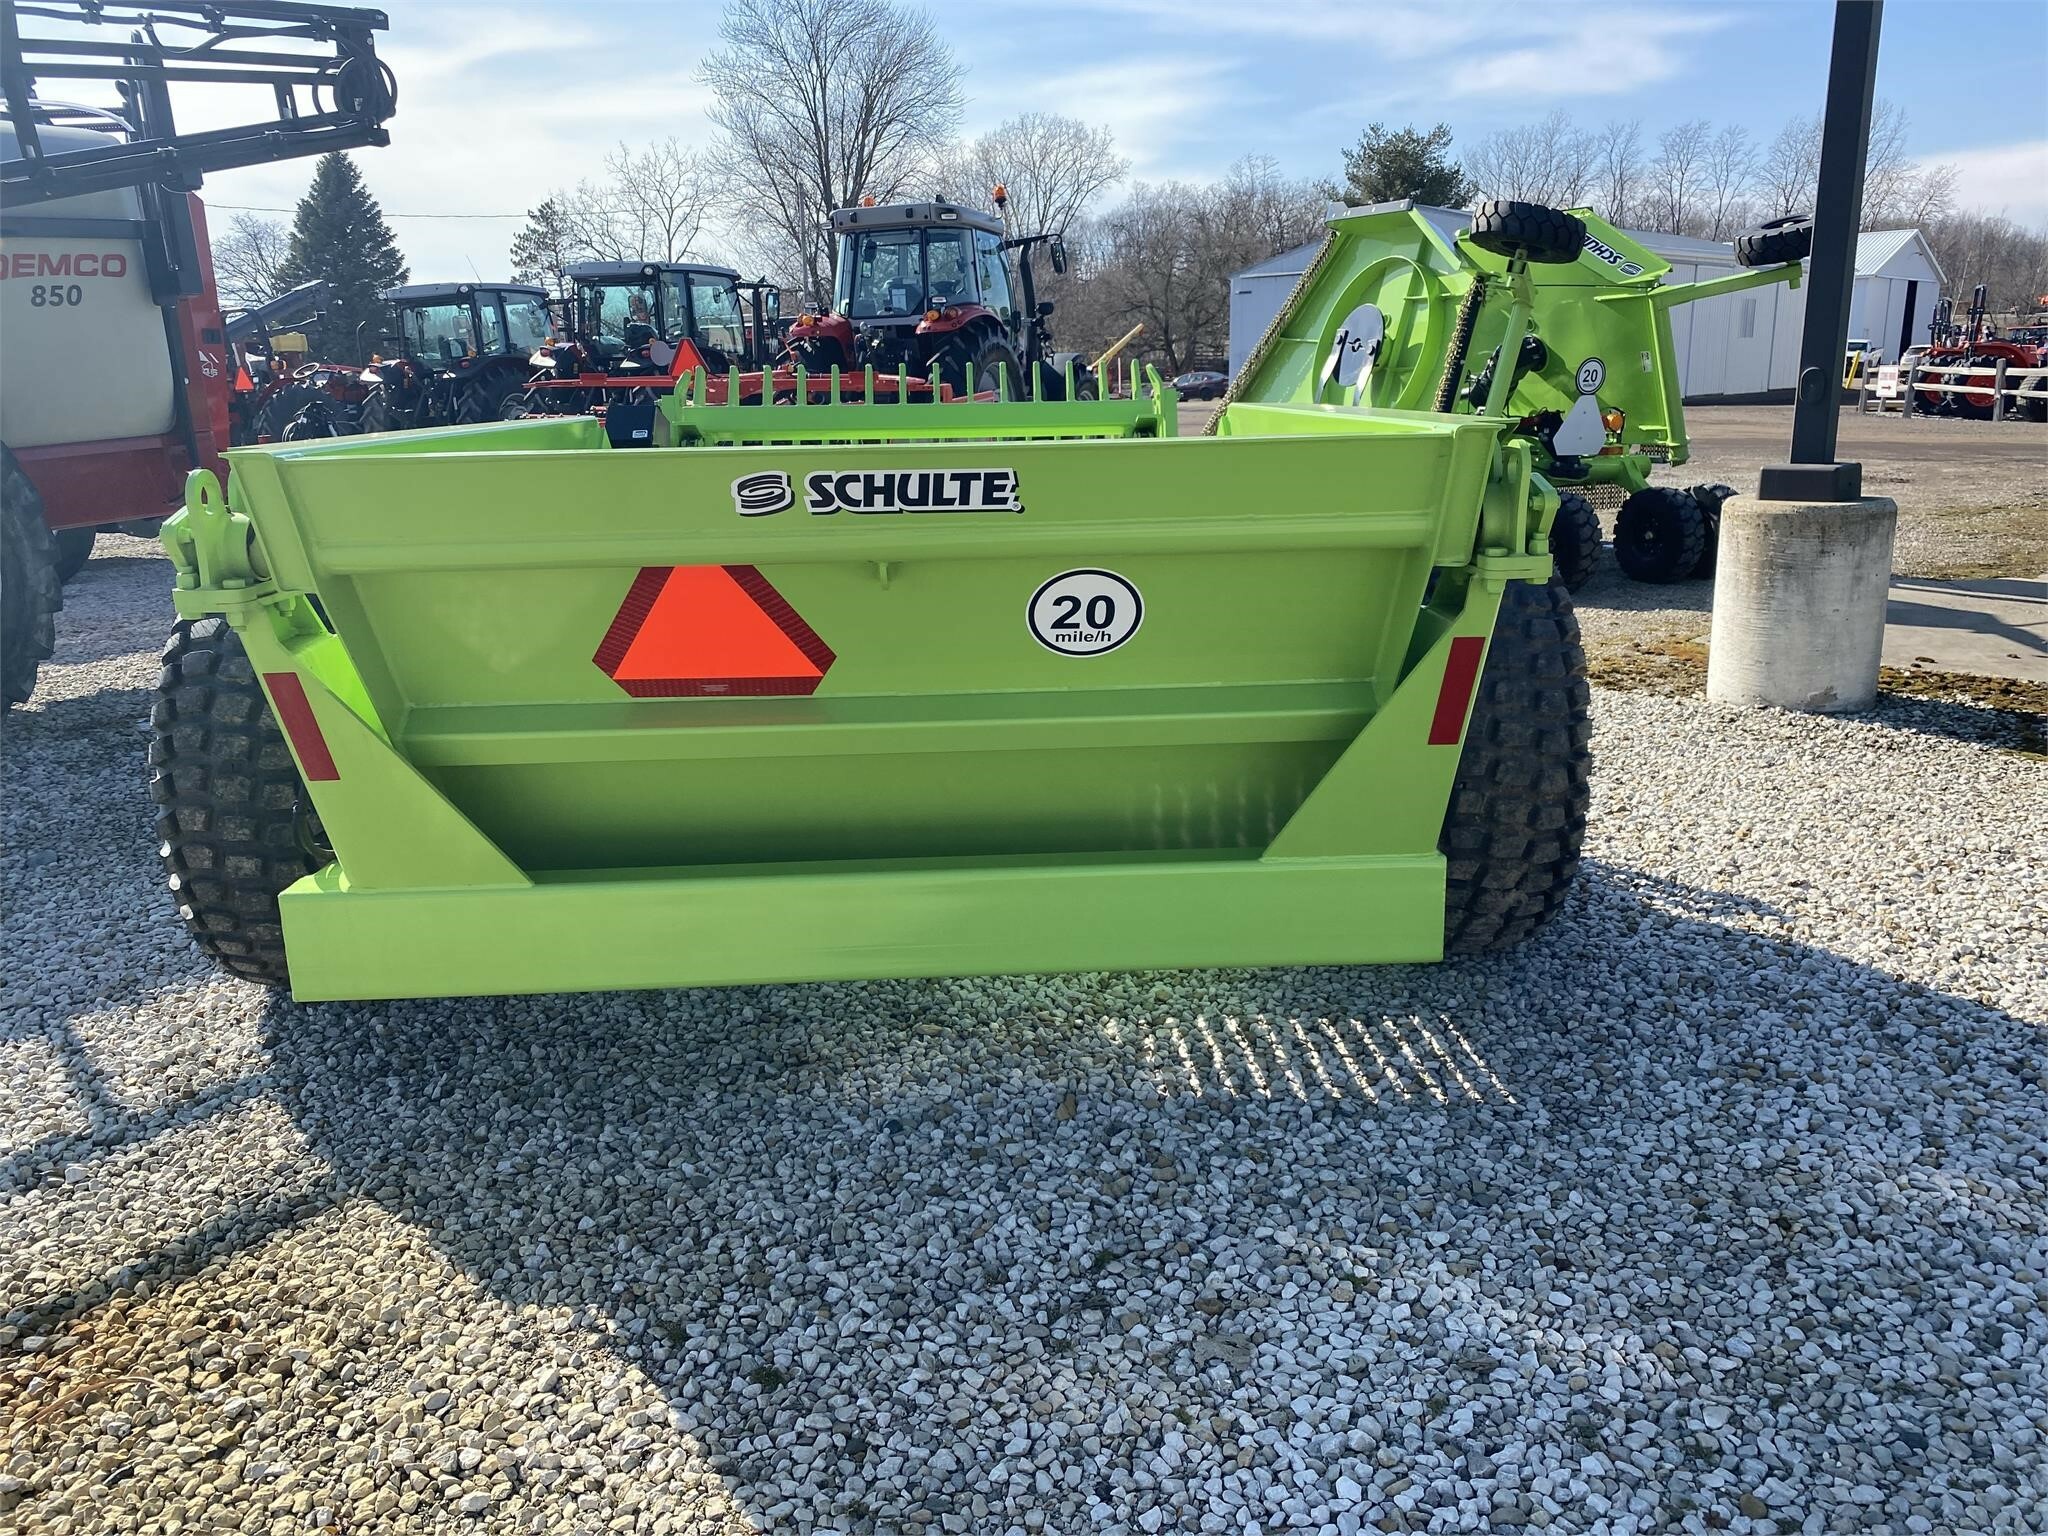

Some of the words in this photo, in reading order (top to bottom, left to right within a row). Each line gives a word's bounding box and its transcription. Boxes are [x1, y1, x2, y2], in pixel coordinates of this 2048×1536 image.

[30, 284, 83, 307] 850
[1582, 369, 1598, 382] 20
[809, 472, 1011, 508] SCHULTE
[1050, 594, 1116, 630] 20
[1055, 630, 1112, 643] mile/h
